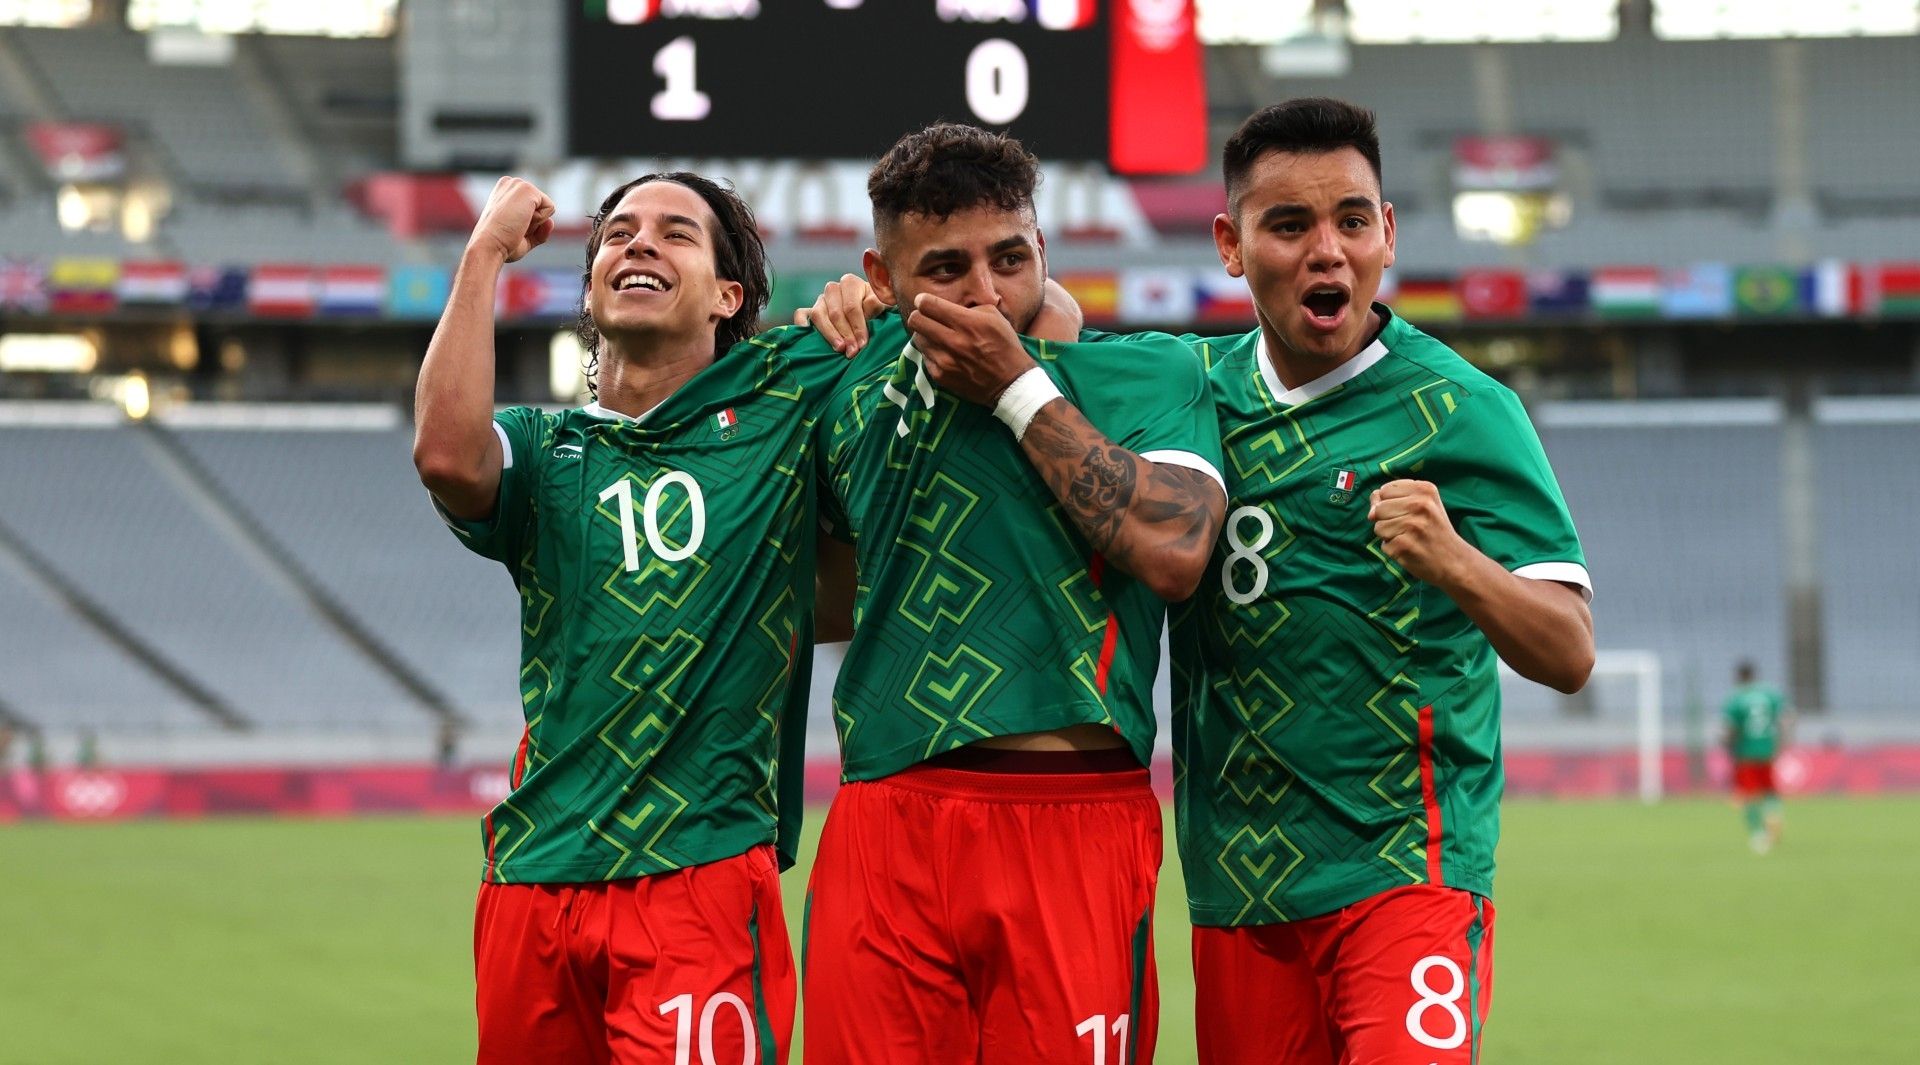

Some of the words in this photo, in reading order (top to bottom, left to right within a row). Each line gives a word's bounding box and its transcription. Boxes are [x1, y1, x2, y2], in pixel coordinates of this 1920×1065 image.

[651, 36, 711, 120] 1
[965, 38, 1029, 125] 0
[599, 470, 706, 572] 10
[1222, 505, 1274, 605] 8
[659, 991, 757, 1065] 10
[1075, 1014, 1129, 1065] 11
[1405, 955, 1467, 1050] 8
